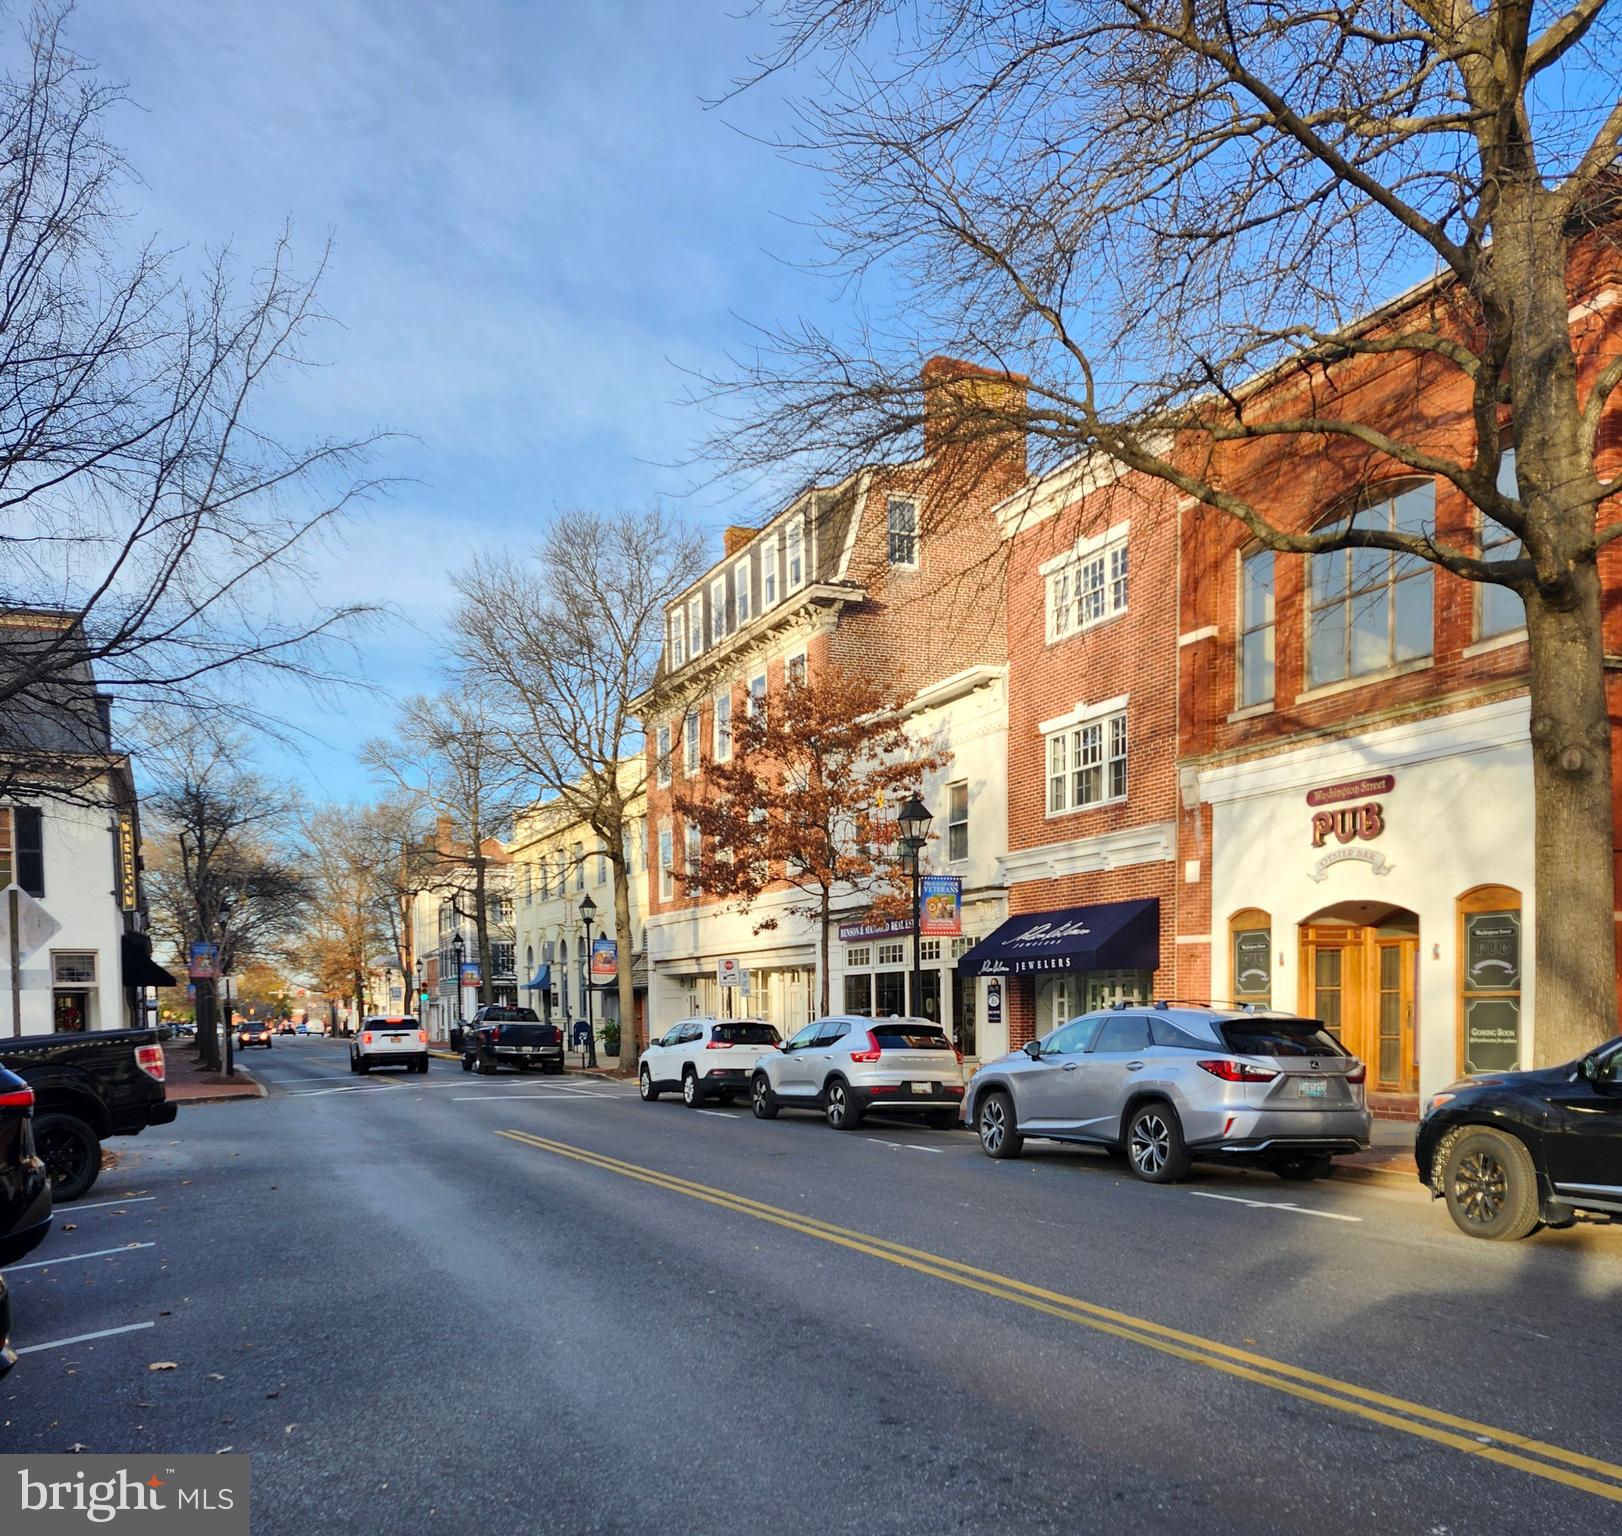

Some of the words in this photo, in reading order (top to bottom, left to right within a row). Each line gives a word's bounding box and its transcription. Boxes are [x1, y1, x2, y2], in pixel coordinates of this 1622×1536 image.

[1313, 785, 1360, 801] Washington
[1361, 780, 1386, 792] Street
[1311, 802, 1386, 848] PUB
[840, 926, 860, 938] BENSON
[890, 919, 904, 931] REAL
[1015, 957, 1071, 973] JEWELERS
